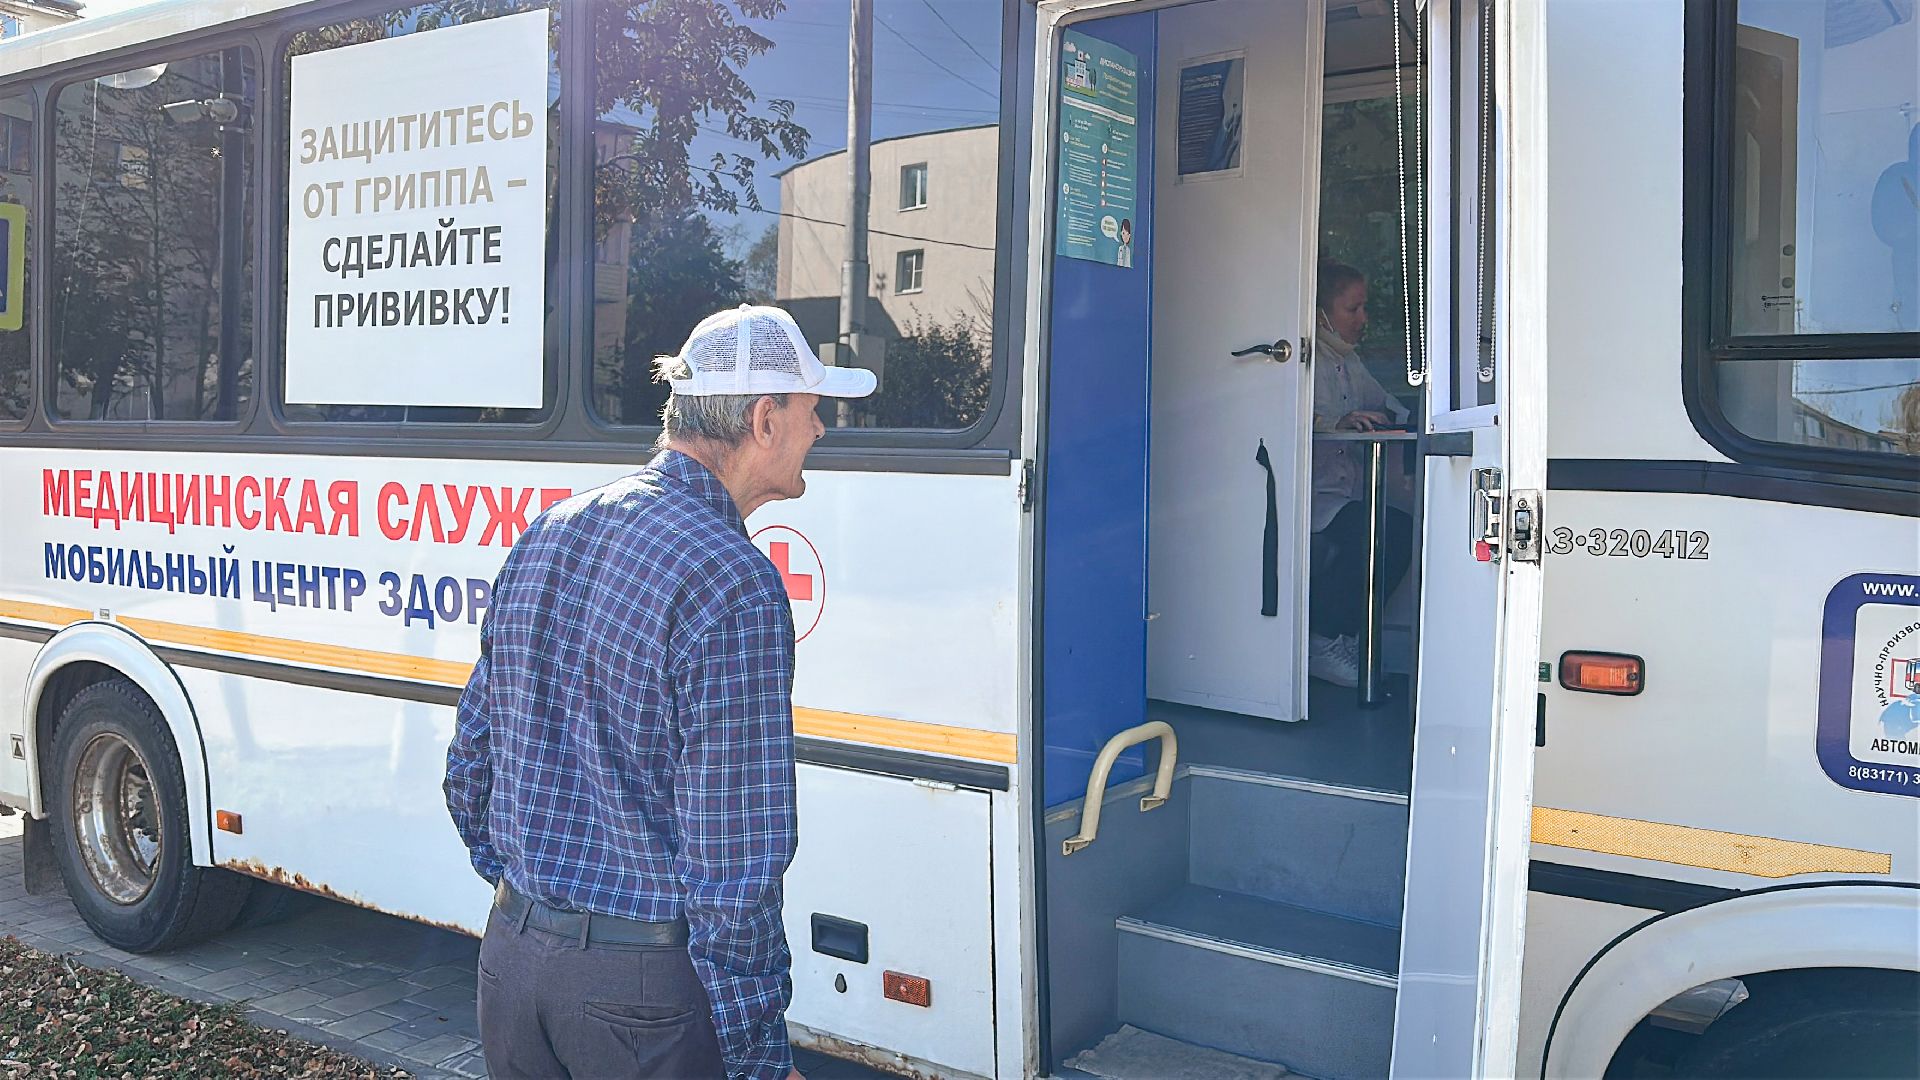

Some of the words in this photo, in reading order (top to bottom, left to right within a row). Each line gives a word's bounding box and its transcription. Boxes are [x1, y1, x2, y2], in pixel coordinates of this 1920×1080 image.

[300, 99, 534, 165] ЗАЩИТИТЕСЬ
[303, 181, 344, 219] ОТ
[355, 165, 494, 214] ГРИППА
[322, 217, 502, 279] СДЕЛАЙТЕ
[314, 286, 511, 328] ПРИВИВКУ!
[42, 468, 359, 537] МЕДИЦИНСКАЯ
[44, 542, 241, 600] МОБИЛЬНЫЙ
[252, 560, 366, 612] ЦЕНТР
[378, 571, 493, 630] ЗДОР
[1862, 582, 1919, 598] www.
[1871, 738, 1920, 755] АВТОМ
[1848, 765, 1909, 786] 8(83171)
